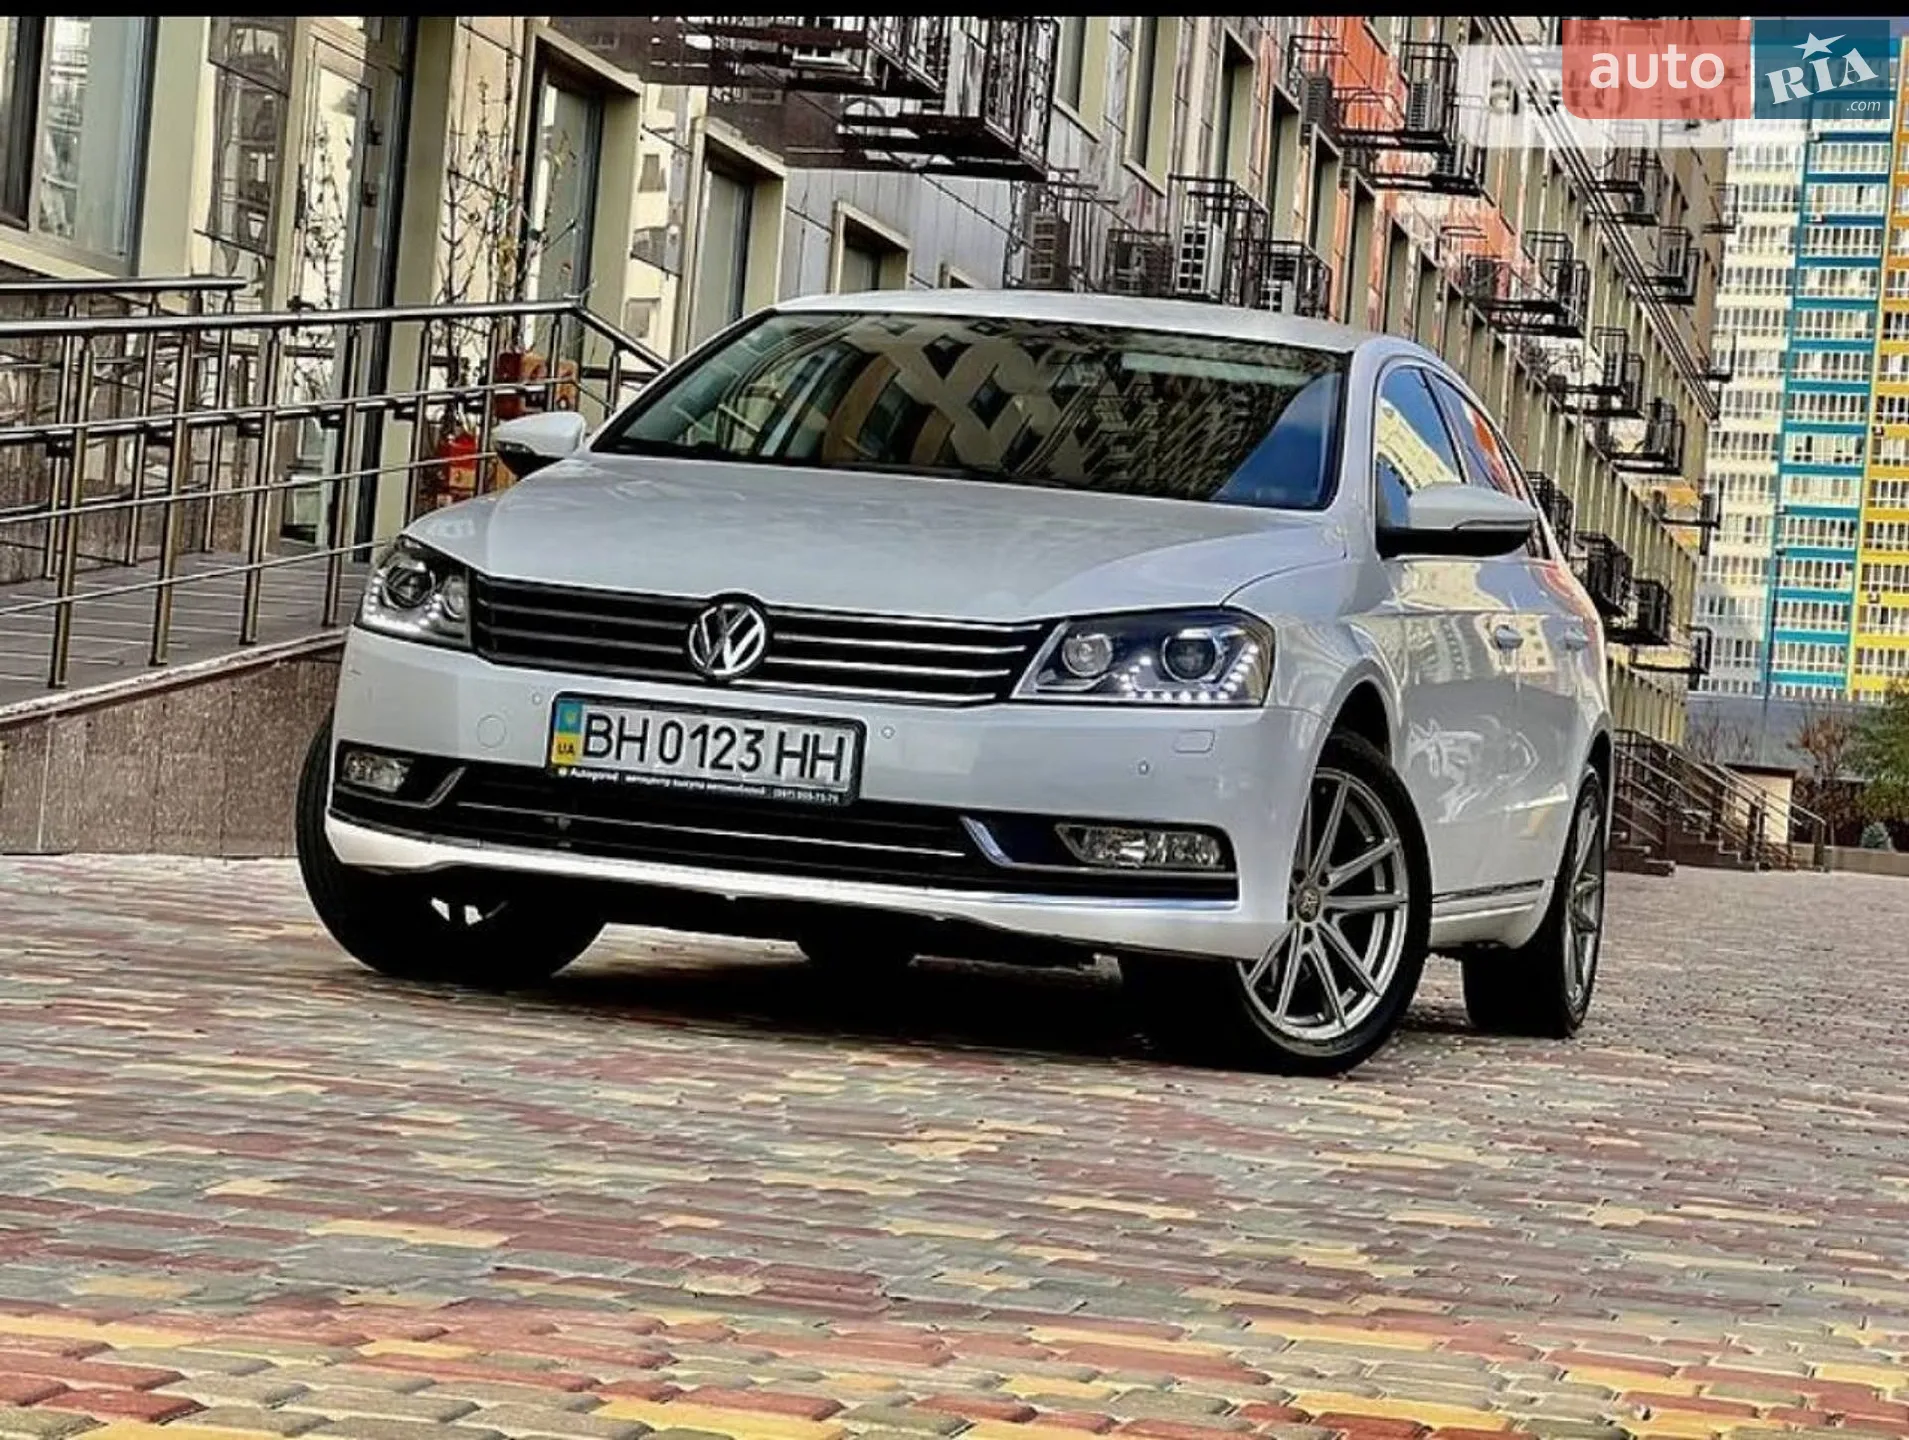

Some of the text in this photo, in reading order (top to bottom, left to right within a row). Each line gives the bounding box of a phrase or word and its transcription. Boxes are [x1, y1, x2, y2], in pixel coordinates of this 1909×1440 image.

[557, 743, 576, 755] UA
[583, 712, 846, 782] BH 0123 HH
